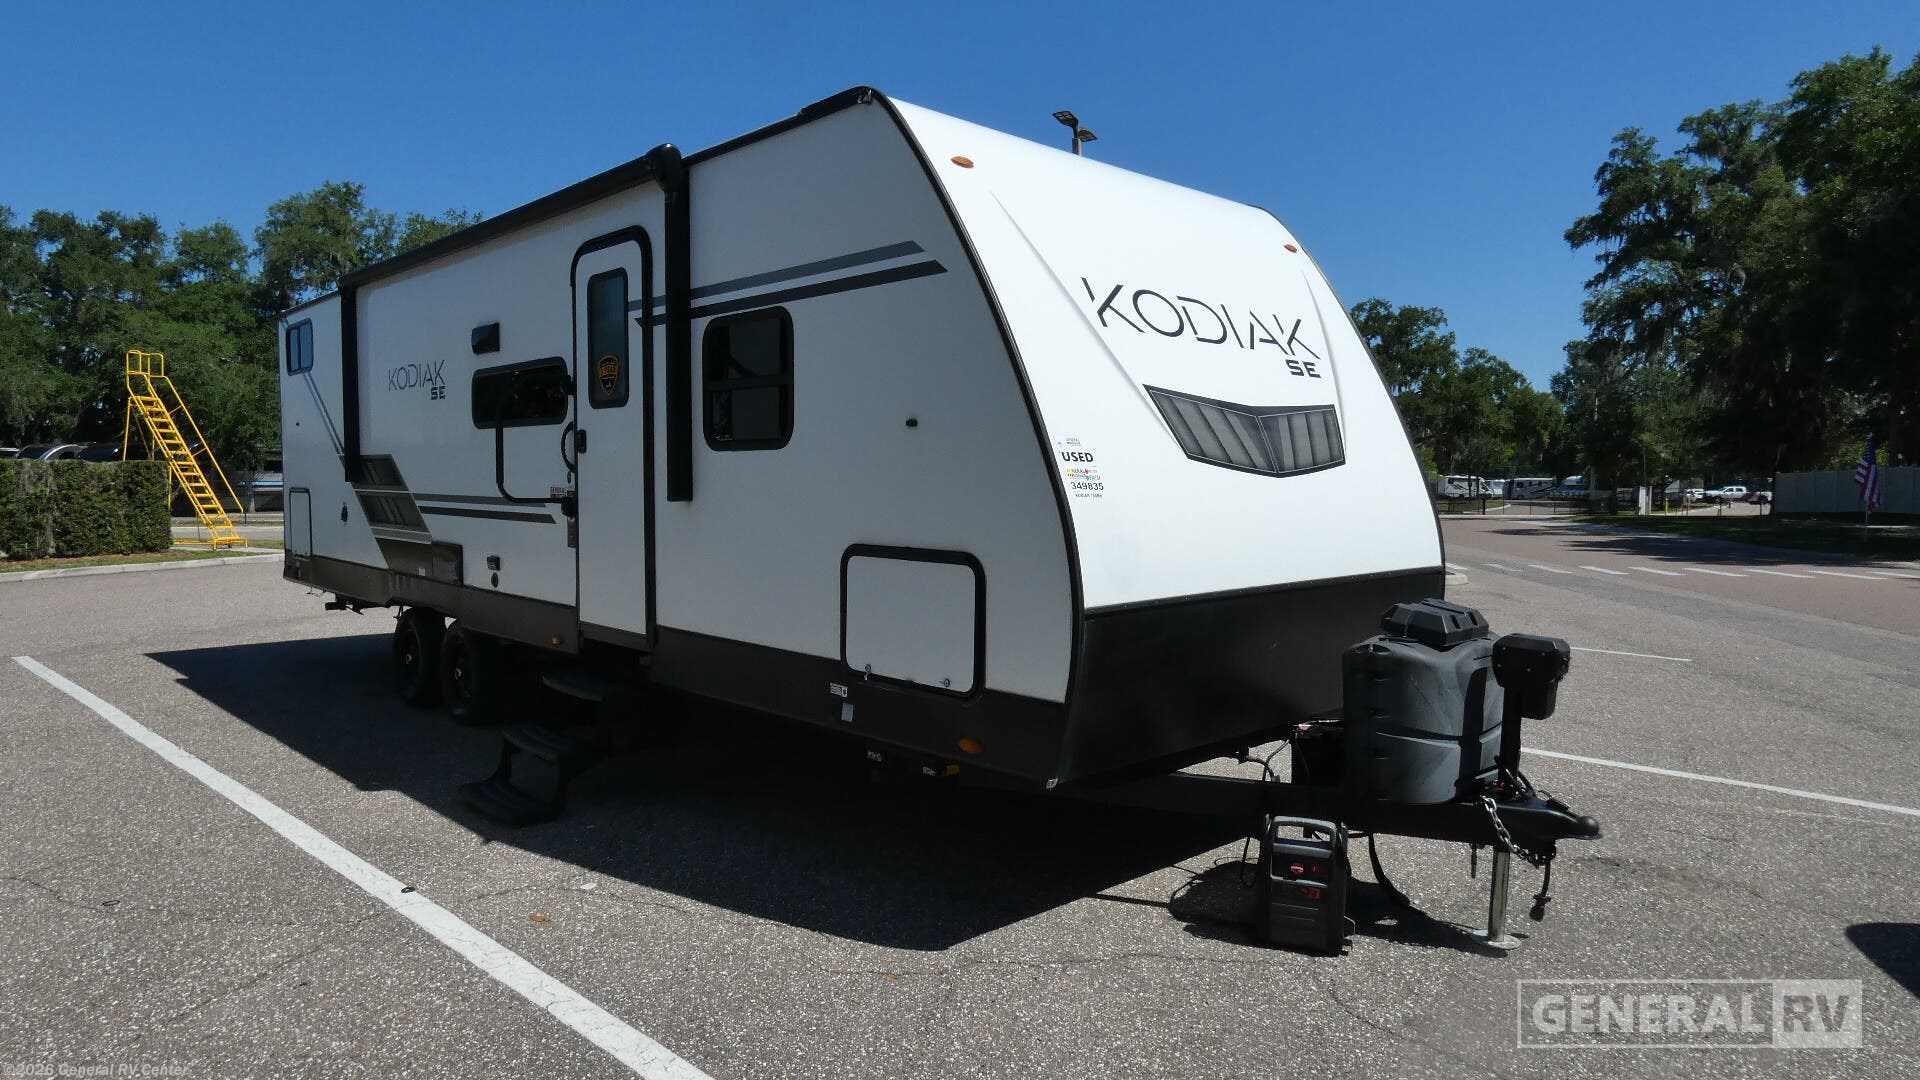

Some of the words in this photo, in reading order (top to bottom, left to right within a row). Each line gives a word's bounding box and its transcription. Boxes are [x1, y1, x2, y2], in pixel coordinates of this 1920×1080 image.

[1080, 276, 1321, 360] KODIAK
[388, 360, 446, 392] KODIAK
[1285, 359, 1321, 379] SE
[430, 386, 446, 401] SE
[1061, 451, 1094, 463] USED
[1070, 481, 1104, 491] 349835
